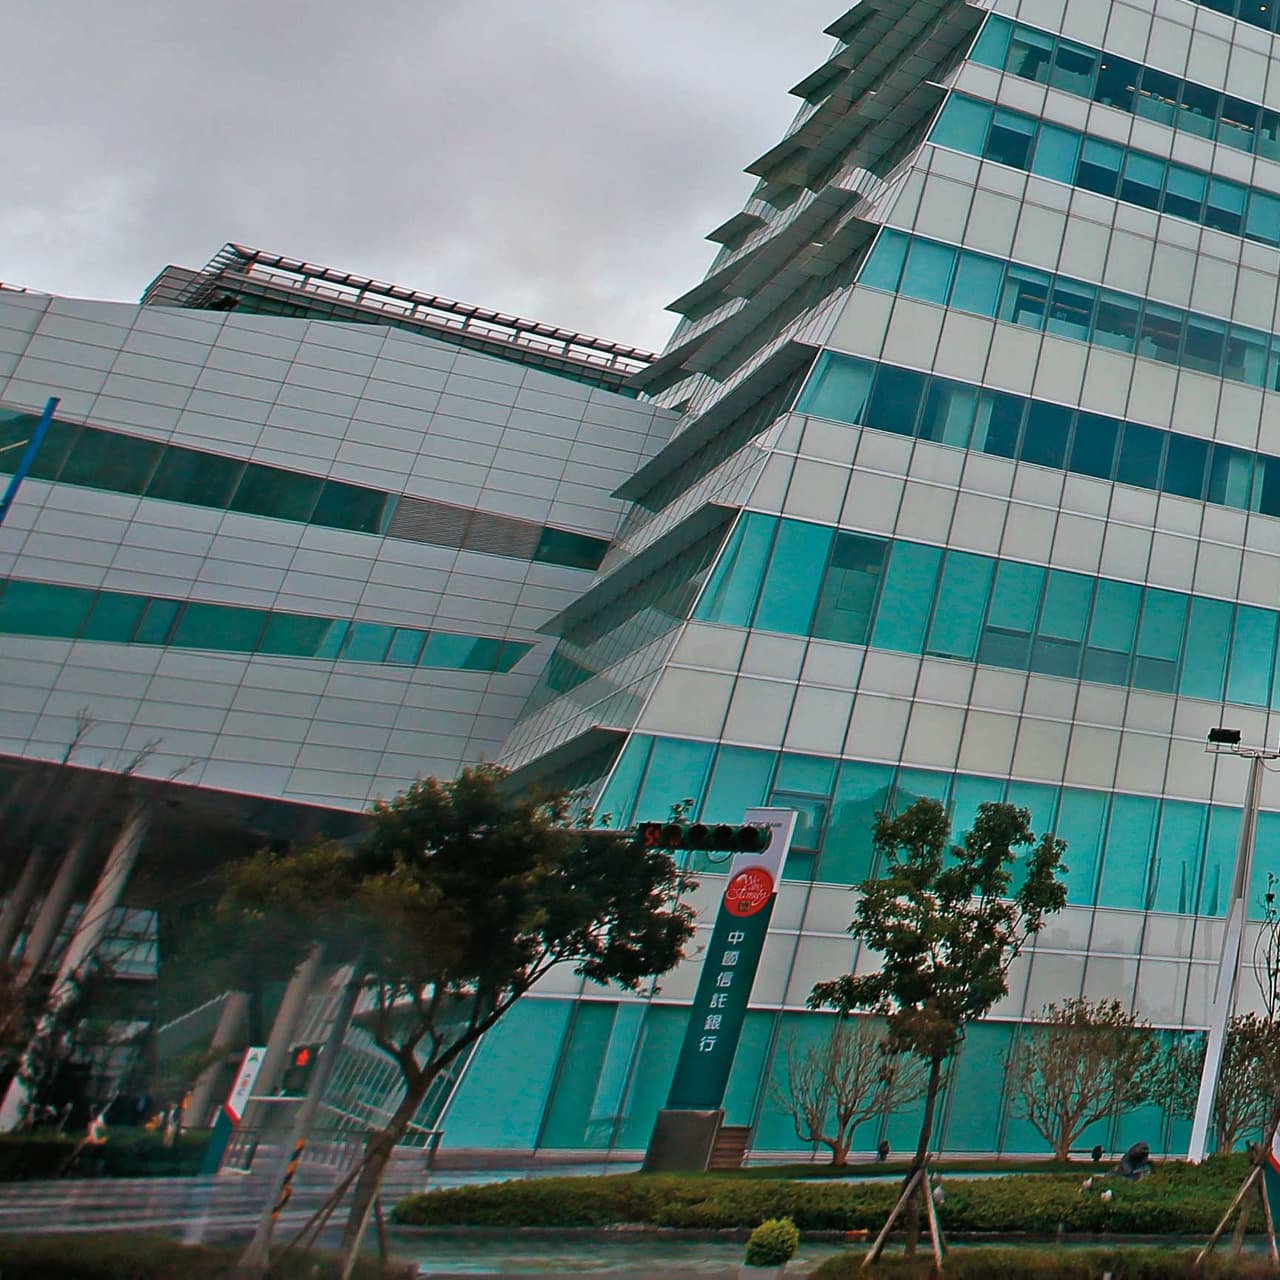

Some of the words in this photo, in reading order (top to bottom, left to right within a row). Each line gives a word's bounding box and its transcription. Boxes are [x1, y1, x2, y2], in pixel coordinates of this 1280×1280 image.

[698, 929, 745, 1052] 中國信託銀行
